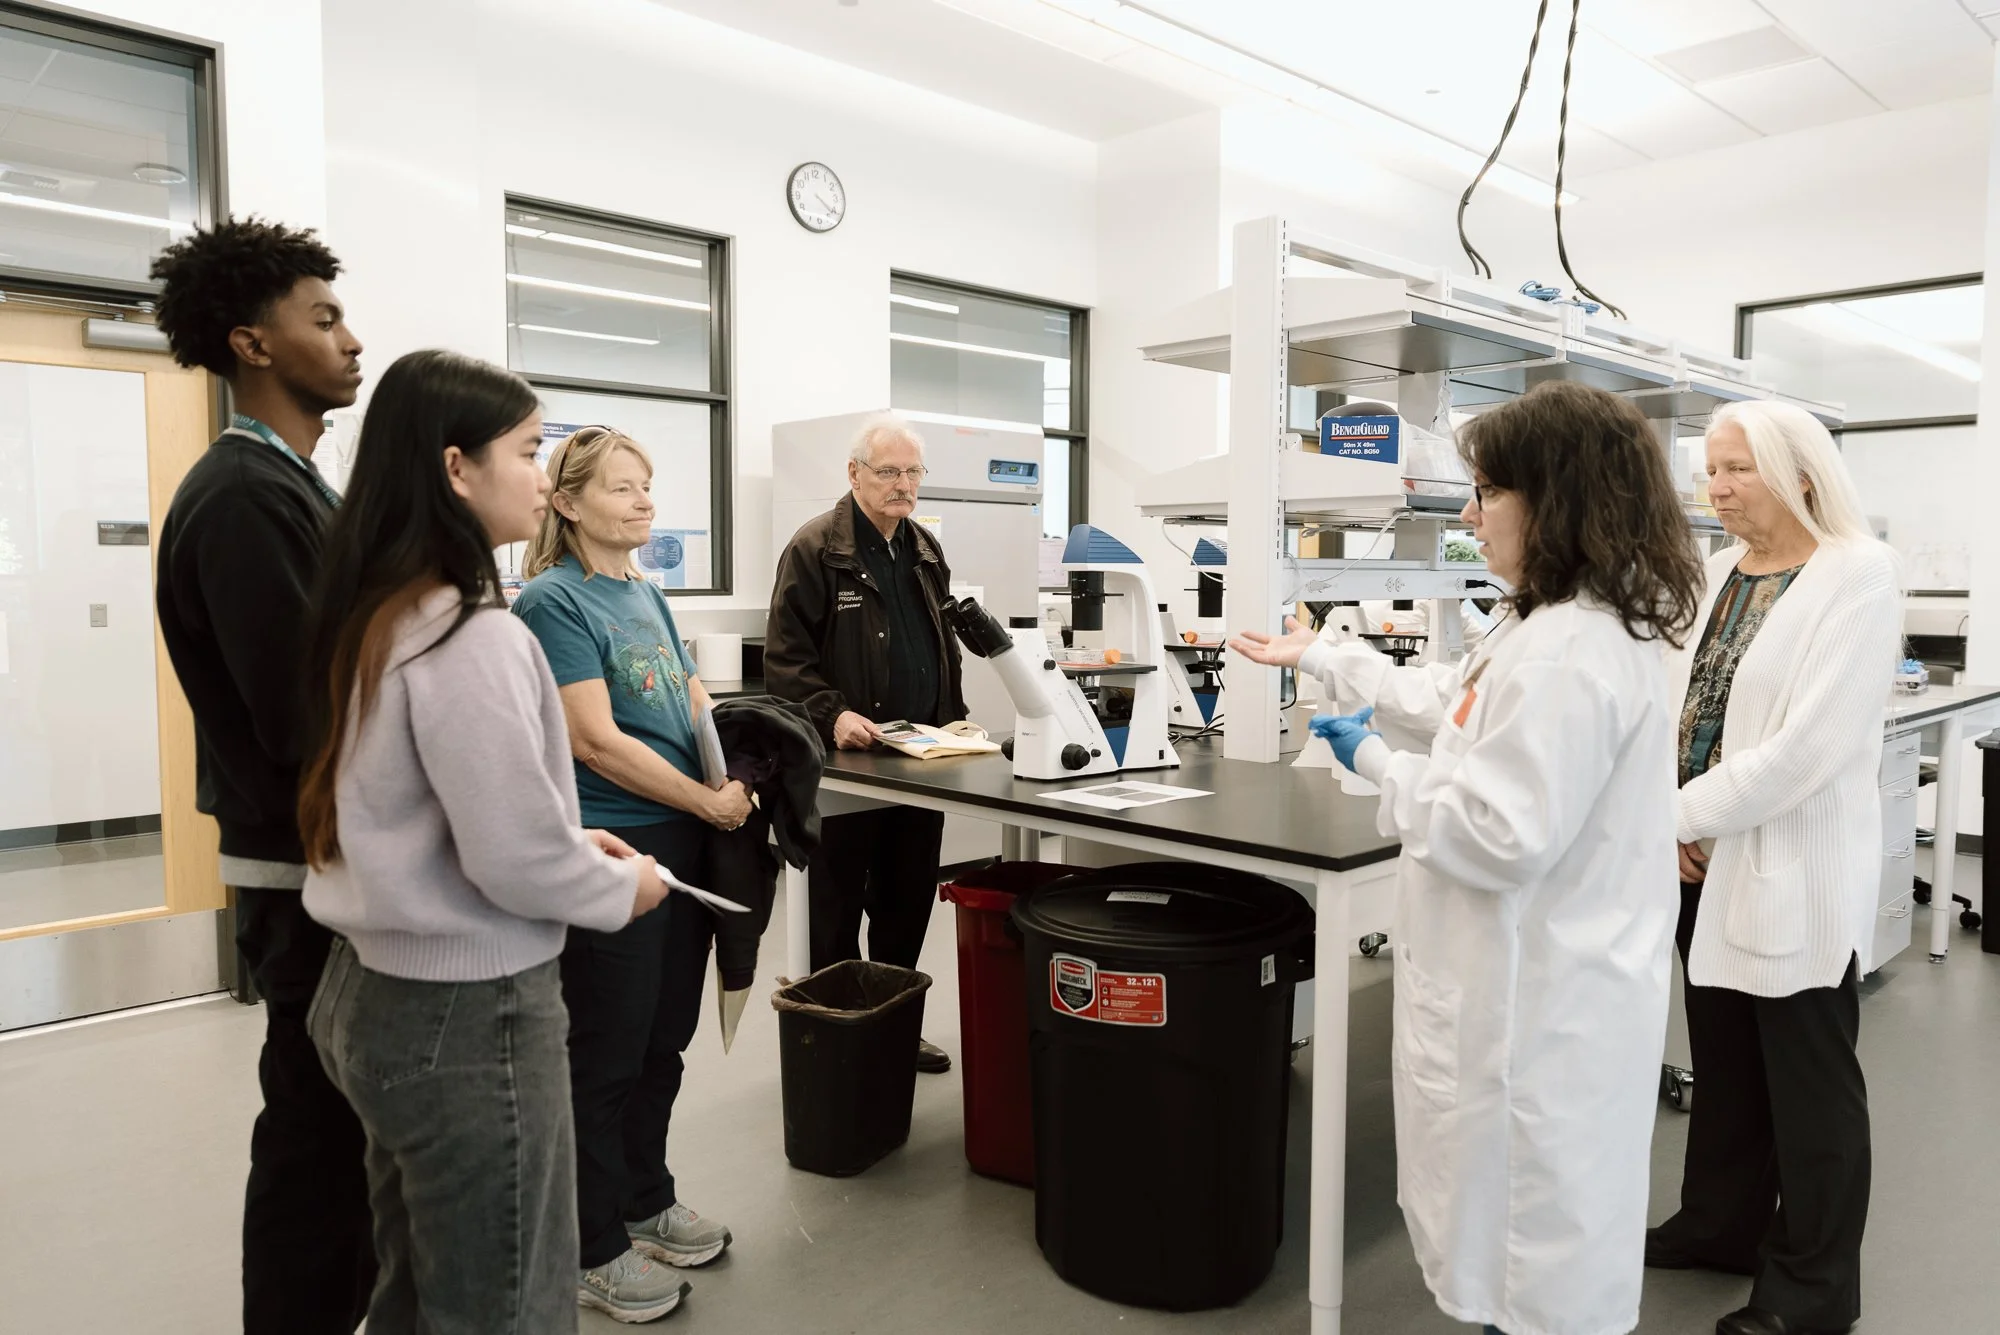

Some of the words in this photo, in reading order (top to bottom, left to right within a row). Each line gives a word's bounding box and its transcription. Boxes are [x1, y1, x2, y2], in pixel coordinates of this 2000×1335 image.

[812, 170, 819, 179] 12
[1126, 977, 1137, 986] 32
[1142, 978, 1156, 986] 121
